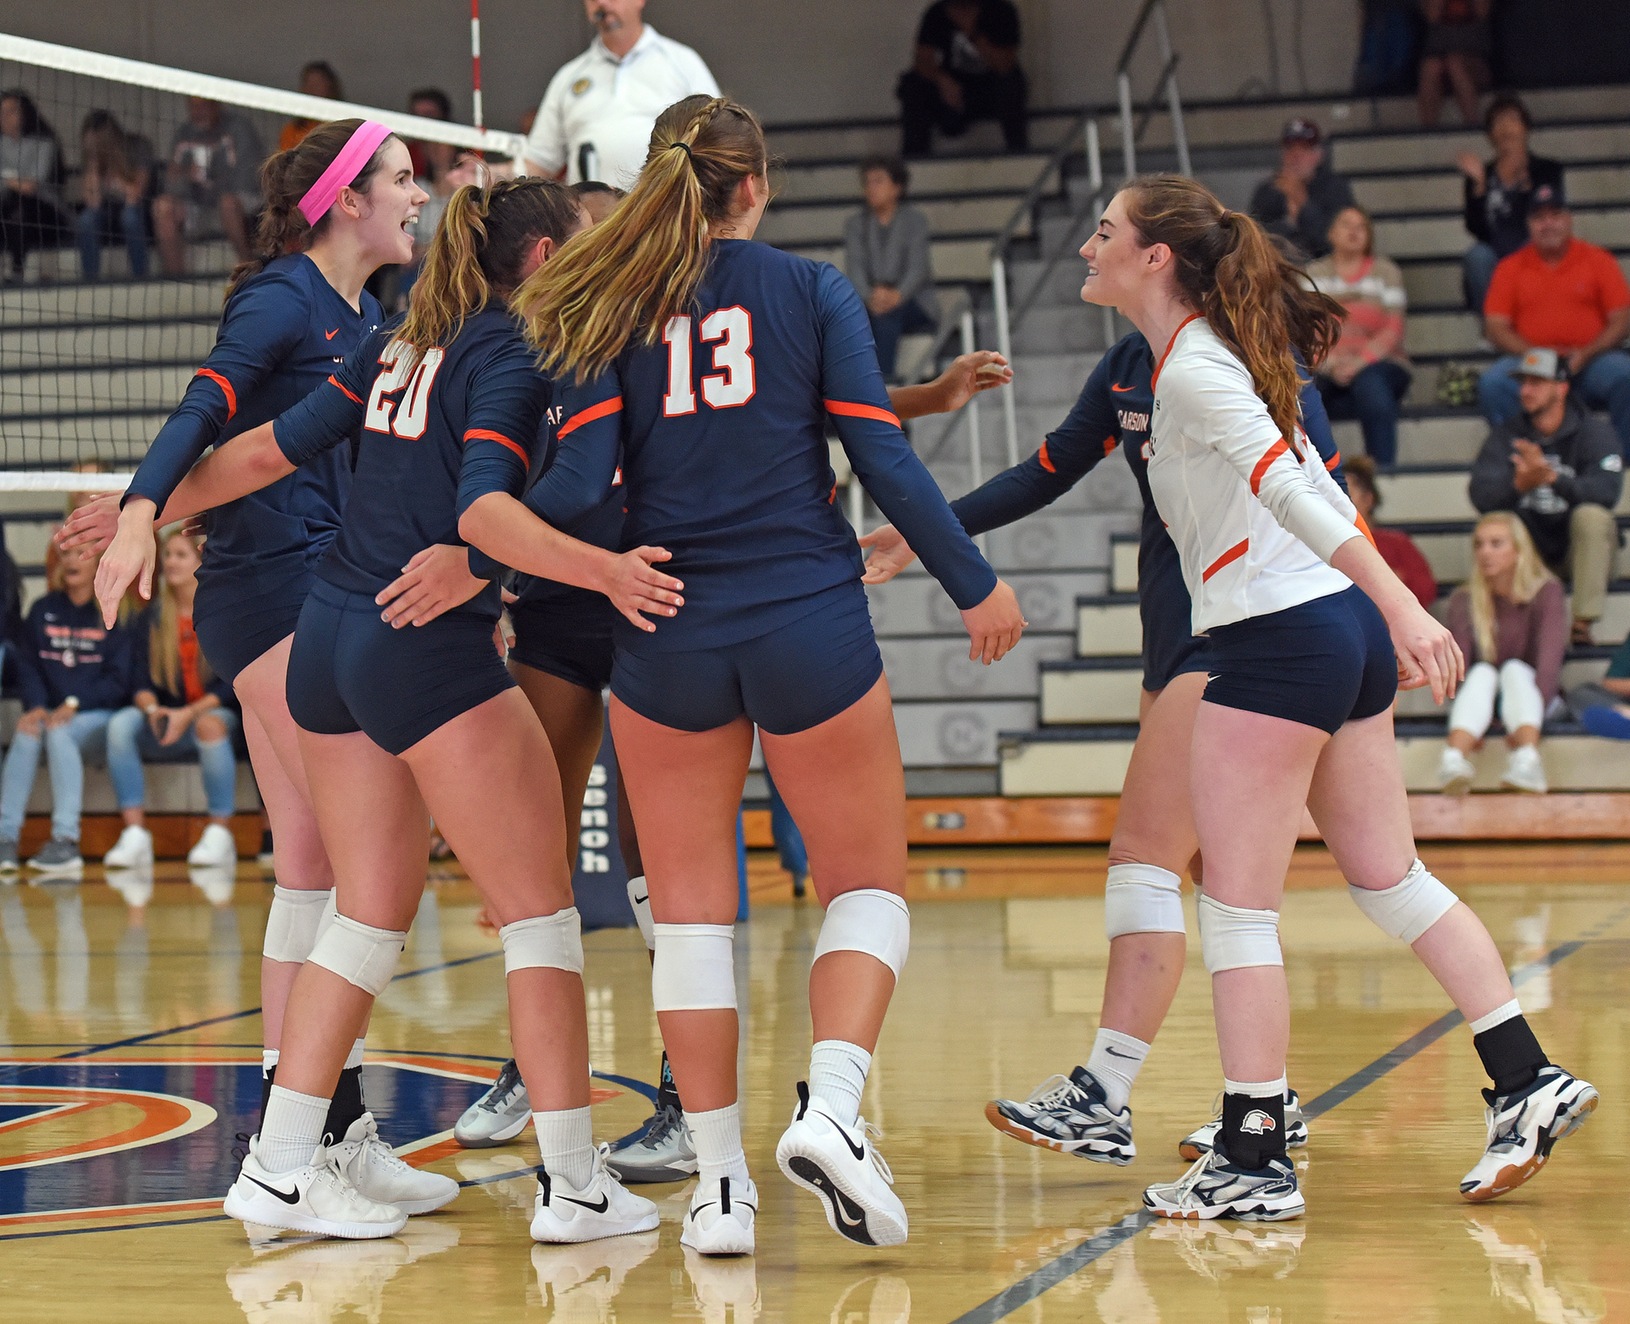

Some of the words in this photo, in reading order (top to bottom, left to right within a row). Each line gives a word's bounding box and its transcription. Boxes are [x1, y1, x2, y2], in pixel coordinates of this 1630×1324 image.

[364, 338, 445, 441] 20
[662, 304, 756, 418] 13
[1118, 409, 1149, 432] CARSON
